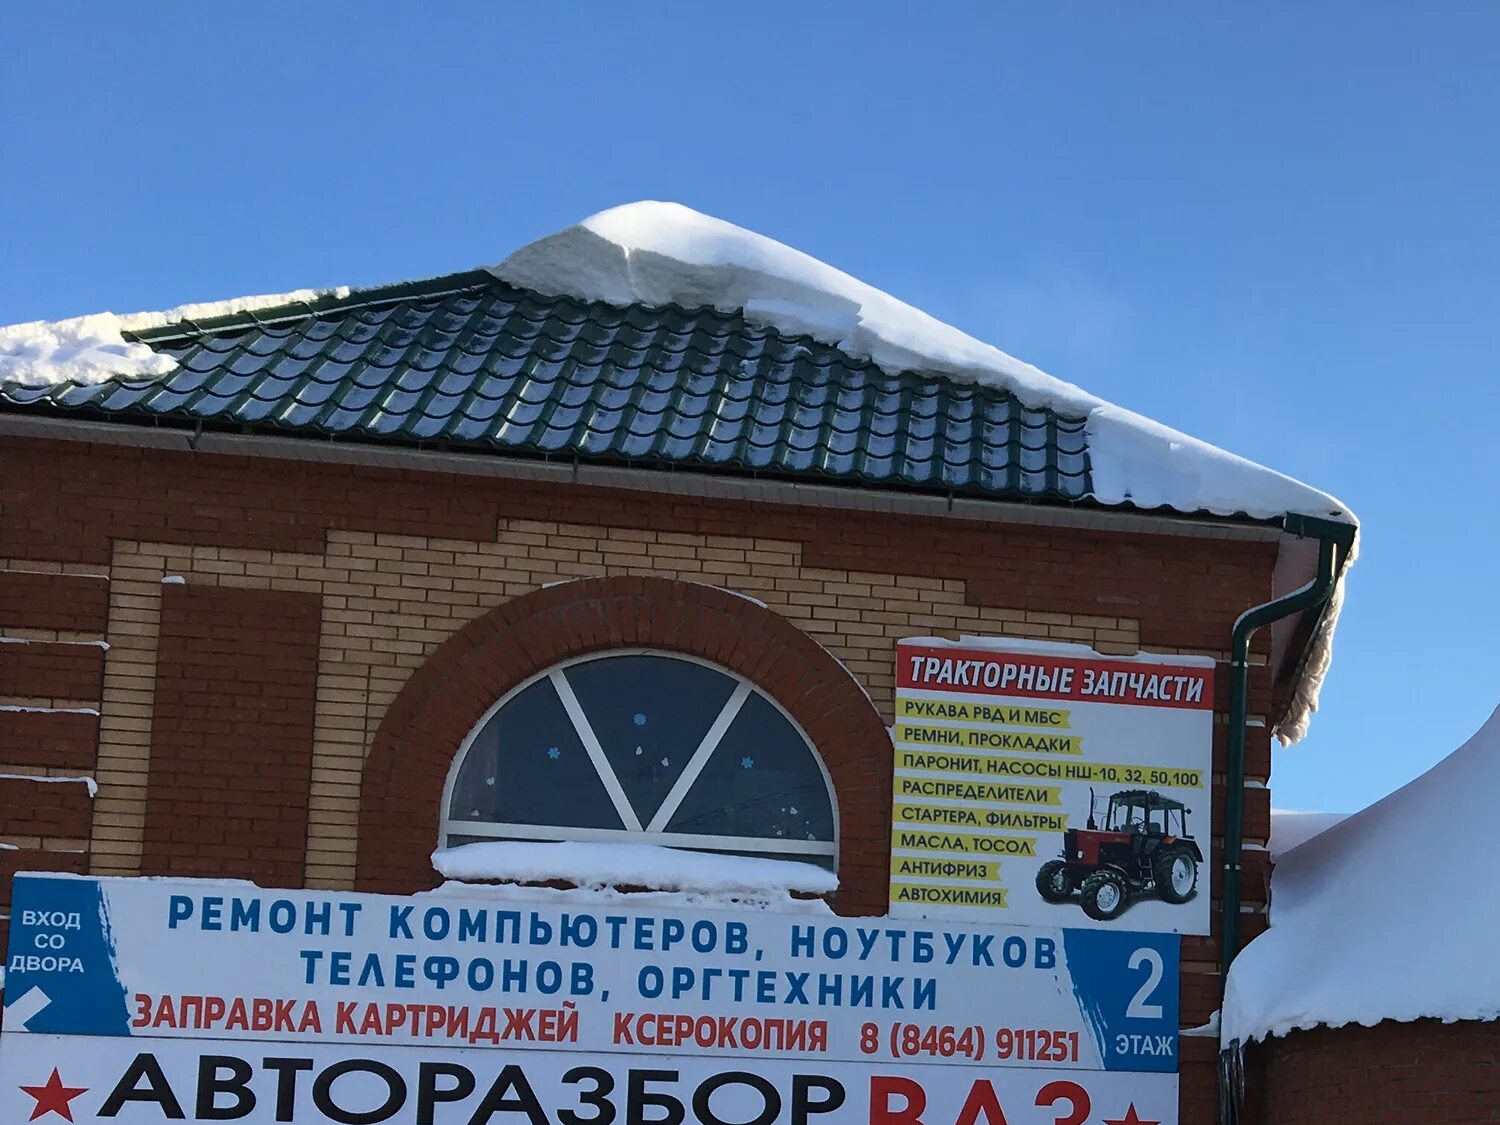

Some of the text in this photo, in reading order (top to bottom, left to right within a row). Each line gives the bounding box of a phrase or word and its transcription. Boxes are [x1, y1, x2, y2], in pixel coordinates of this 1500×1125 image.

[911, 656, 1204, 702] ТРАКТОРНЫЕ ЗАПЧАСТИ
[904, 701, 1062, 725] РУКАВА РВД И МБС
[904, 728, 1071, 752] РЕМНИ, ПРОКЛАДКИ
[903, 755, 982, 773] ПАРОНИТ,
[987, 759, 1061, 778] НАСОСЫ
[1125, 769, 1146, 784] 32,
[902, 781, 1048, 802] РАСПРЕДЕЛИТЕЛИ
[901, 806, 1061, 829] СТАРТЕРА, ФИЛЬТРЫ
[901, 834, 1031, 854] МАСЛА, ТОСОЛ
[900, 861, 987, 878] АНТИФРИЗ
[899, 887, 1001, 905] АВТОХИМИЯ
[22, 910, 81, 930] ВХОД
[34, 933, 65, 949] СО
[168, 895, 1055, 969] РЕМОНТ КОМПЬЮТЕРОВ, НОУТБУКОВ
[10, 956, 84, 973] ДВОРА
[300, 950, 936, 1010] ТЕЛЕФОНОВ, ОРГТЕХНИКИ
[1126, 947, 1163, 1019] 2
[132, 993, 1079, 1061] ЗАПРАВКА КАРТРИДЖЕЙ КСЕРОКОПИЯ 8 (8464) 911251
[1115, 1034, 1173, 1056] ЭТАЖ
